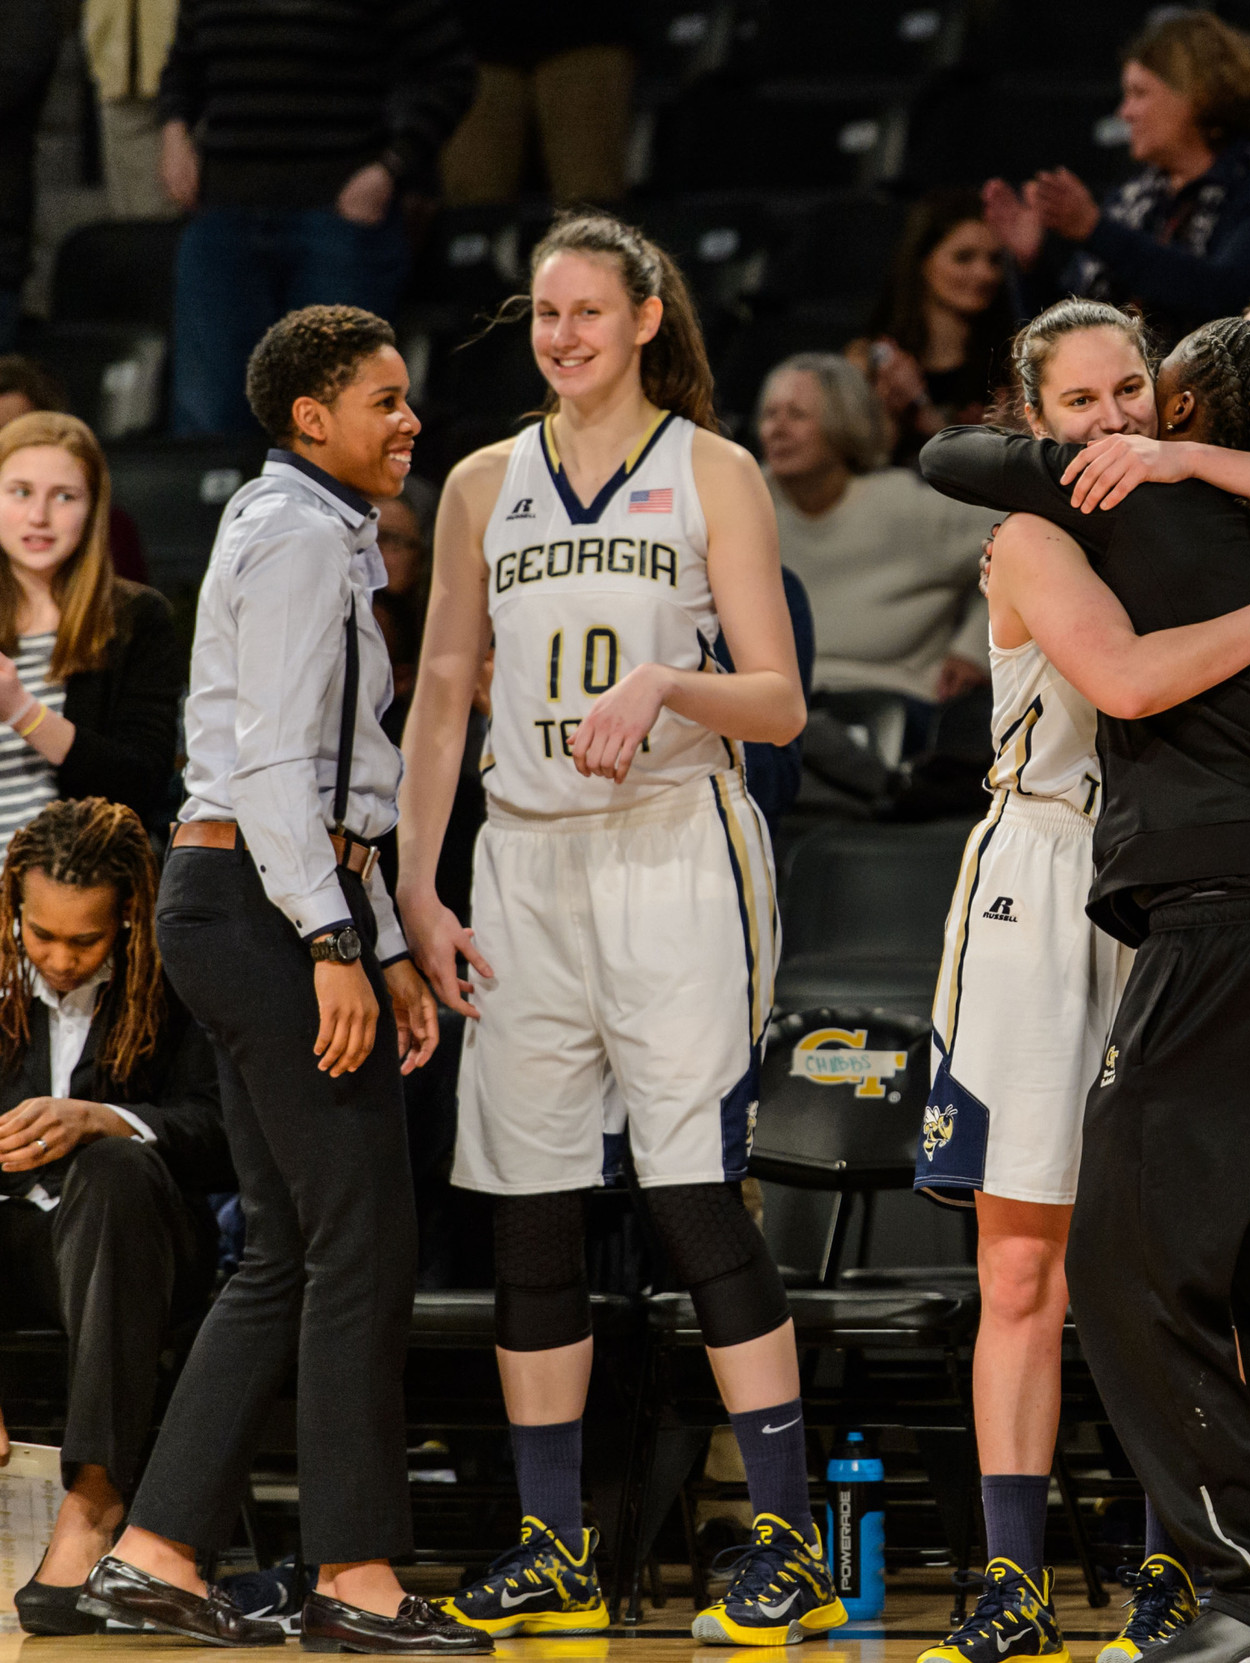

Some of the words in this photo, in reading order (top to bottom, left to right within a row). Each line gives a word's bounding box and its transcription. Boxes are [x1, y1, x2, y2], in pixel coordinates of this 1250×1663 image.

[496, 536, 678, 595] GEORGIA
[546, 624, 621, 702] 10
[982, 911, 1018, 923] RUSSELL
[840, 1490, 852, 1591] POWERADE
